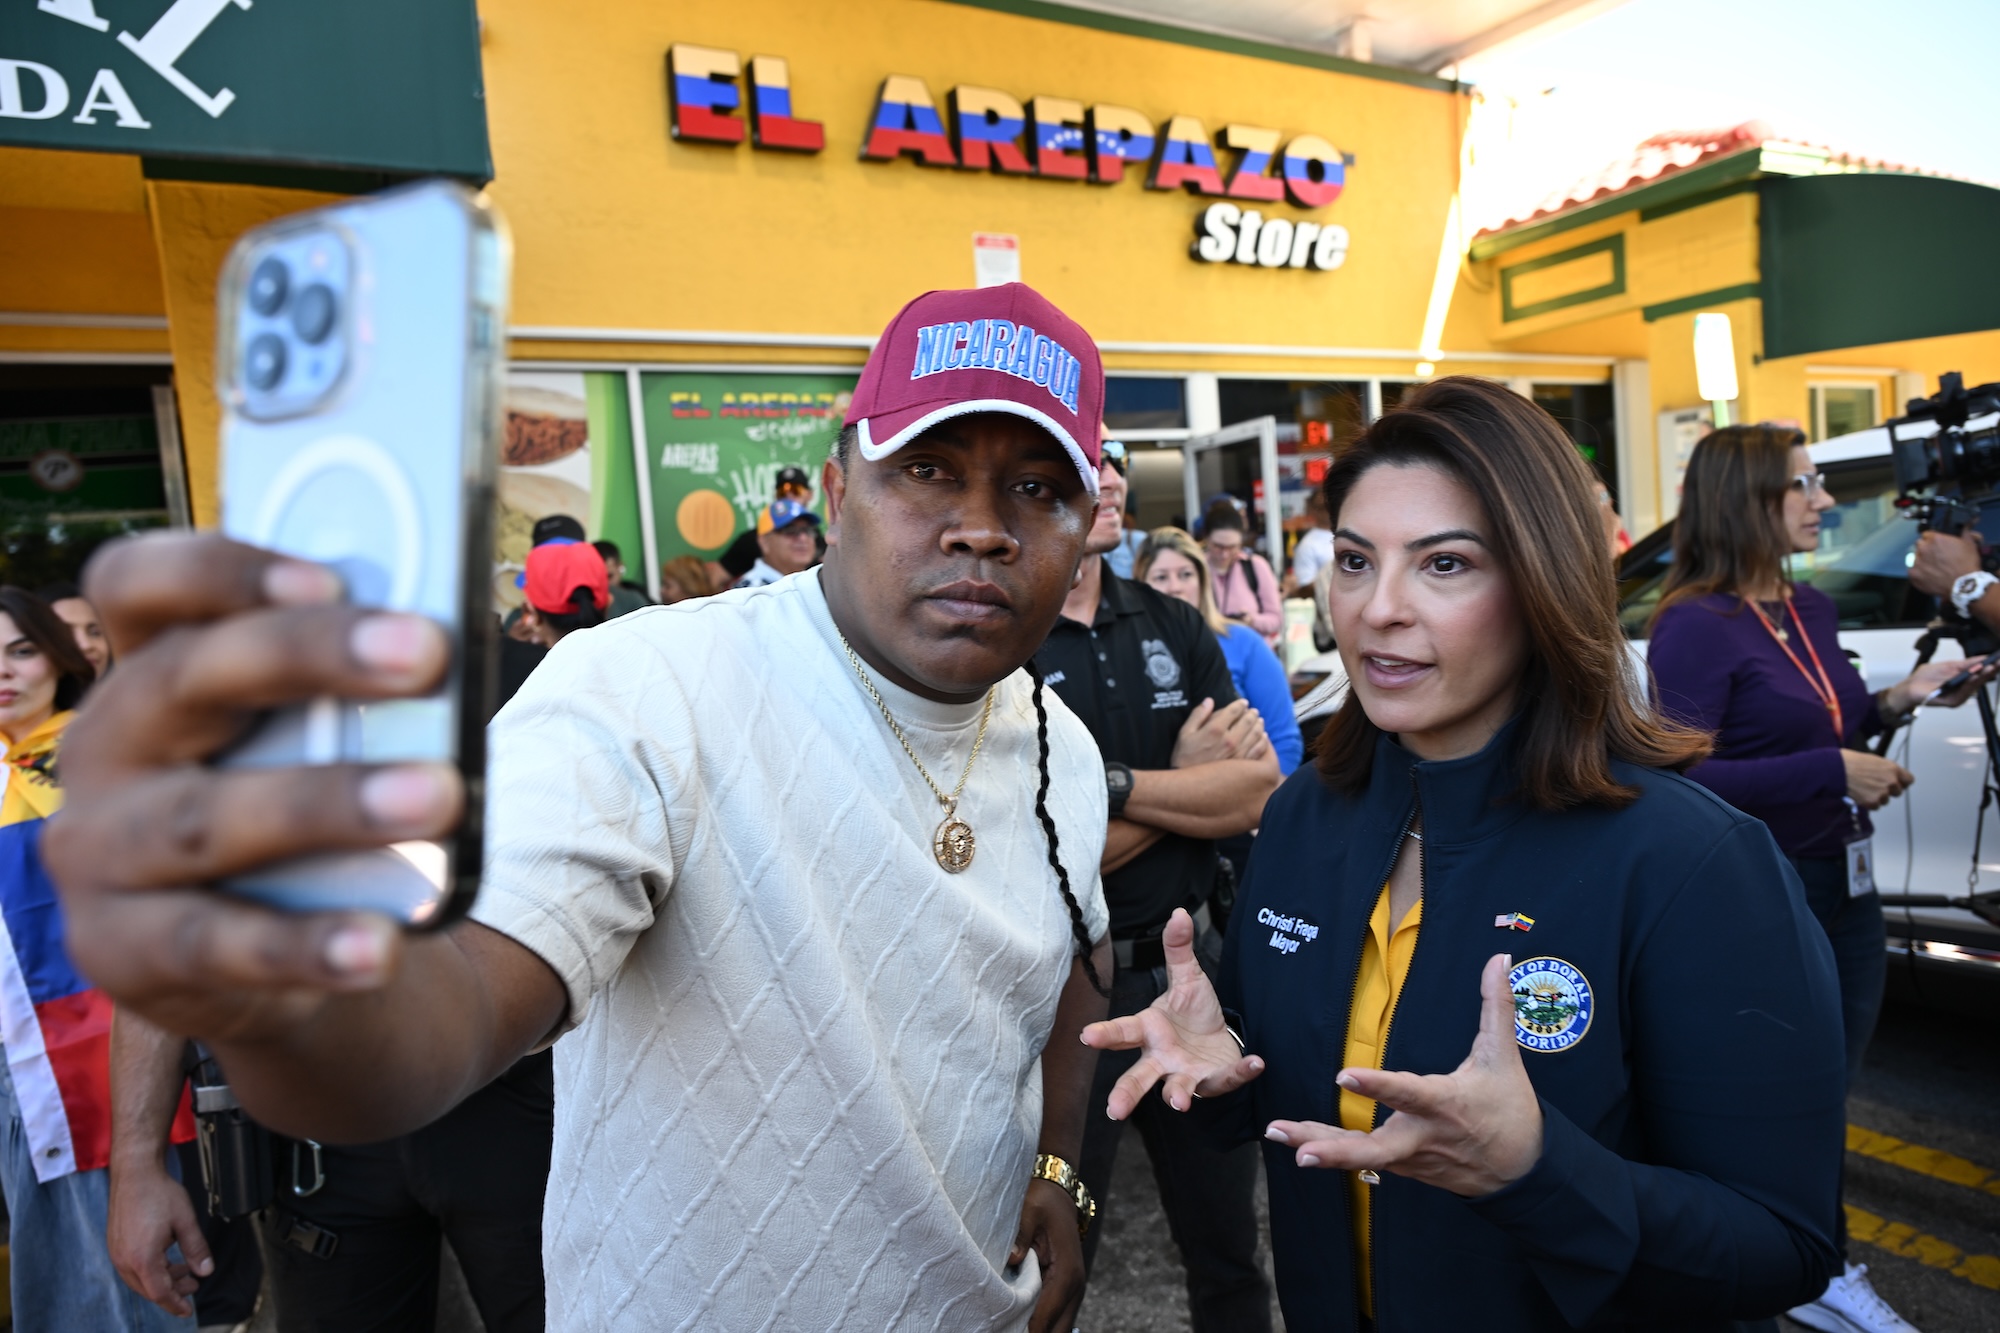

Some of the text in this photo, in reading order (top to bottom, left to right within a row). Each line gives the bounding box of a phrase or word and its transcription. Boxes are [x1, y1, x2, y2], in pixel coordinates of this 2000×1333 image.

[666, 42, 1347, 209] EL AREPAZO
[1196, 202, 1350, 271] Store
[910, 318, 1081, 416] NICARAGUA
[670, 392, 837, 419] EL AREPAZ
[1257, 907, 1319, 942] Christi Fraga
[1269, 930, 1300, 955] Mayor
[1527, 961, 1546, 972] OF
[1548, 960, 1590, 1003] DORAL
